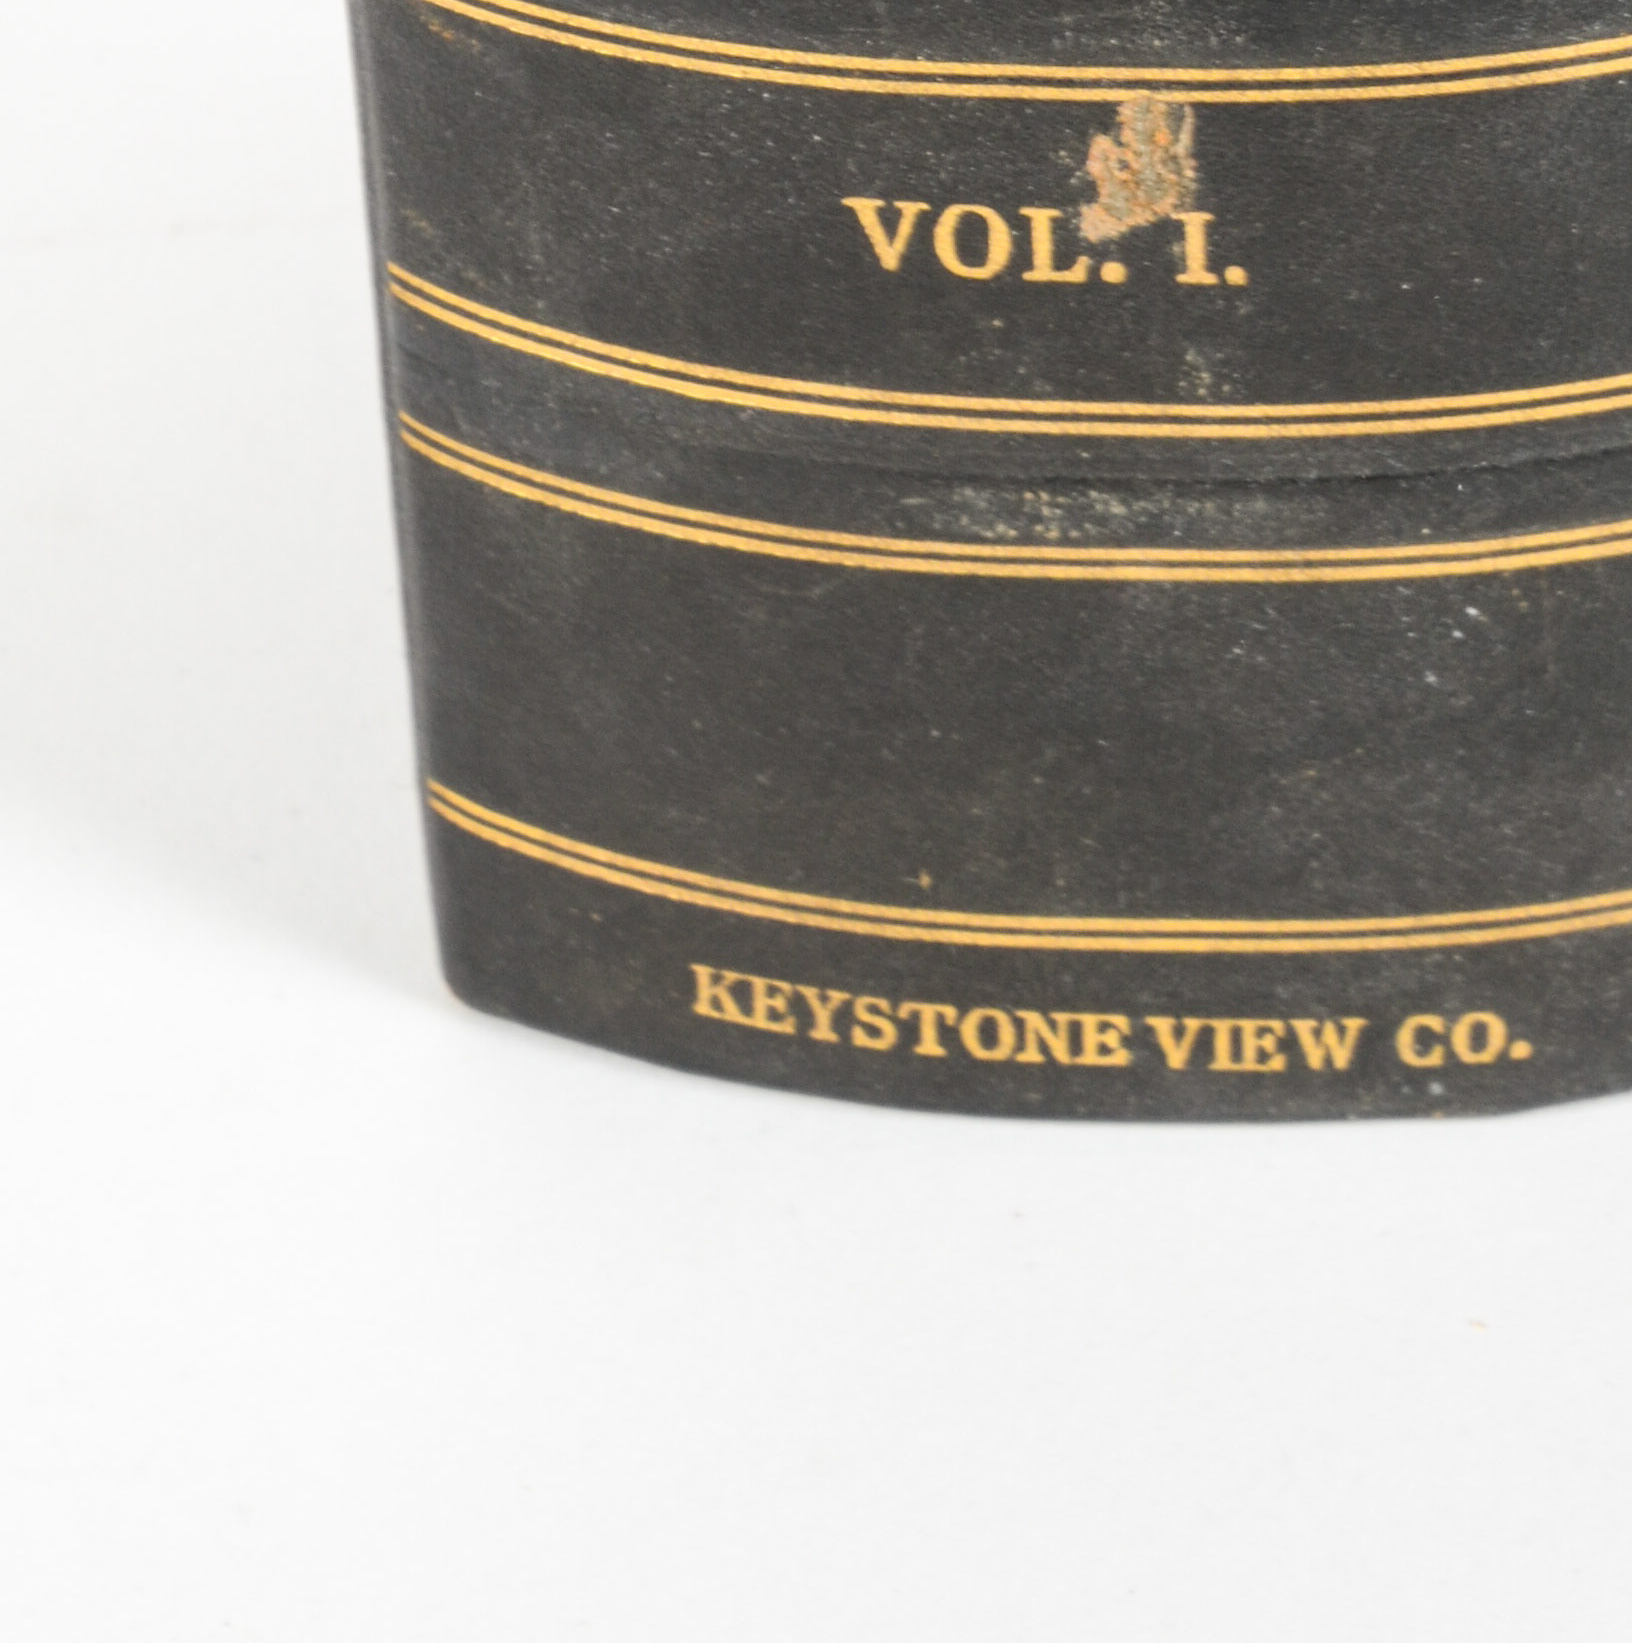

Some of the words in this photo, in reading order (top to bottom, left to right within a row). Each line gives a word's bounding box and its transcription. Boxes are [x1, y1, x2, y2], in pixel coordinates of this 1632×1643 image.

[841, 196, 1128, 283] VOL.
[1170, 210, 1249, 286] I.
[690, 963, 1131, 1067] KEYSTONE
[1144, 1015, 1368, 1073] VIEW
[1397, 1011, 1532, 1067] CO.
